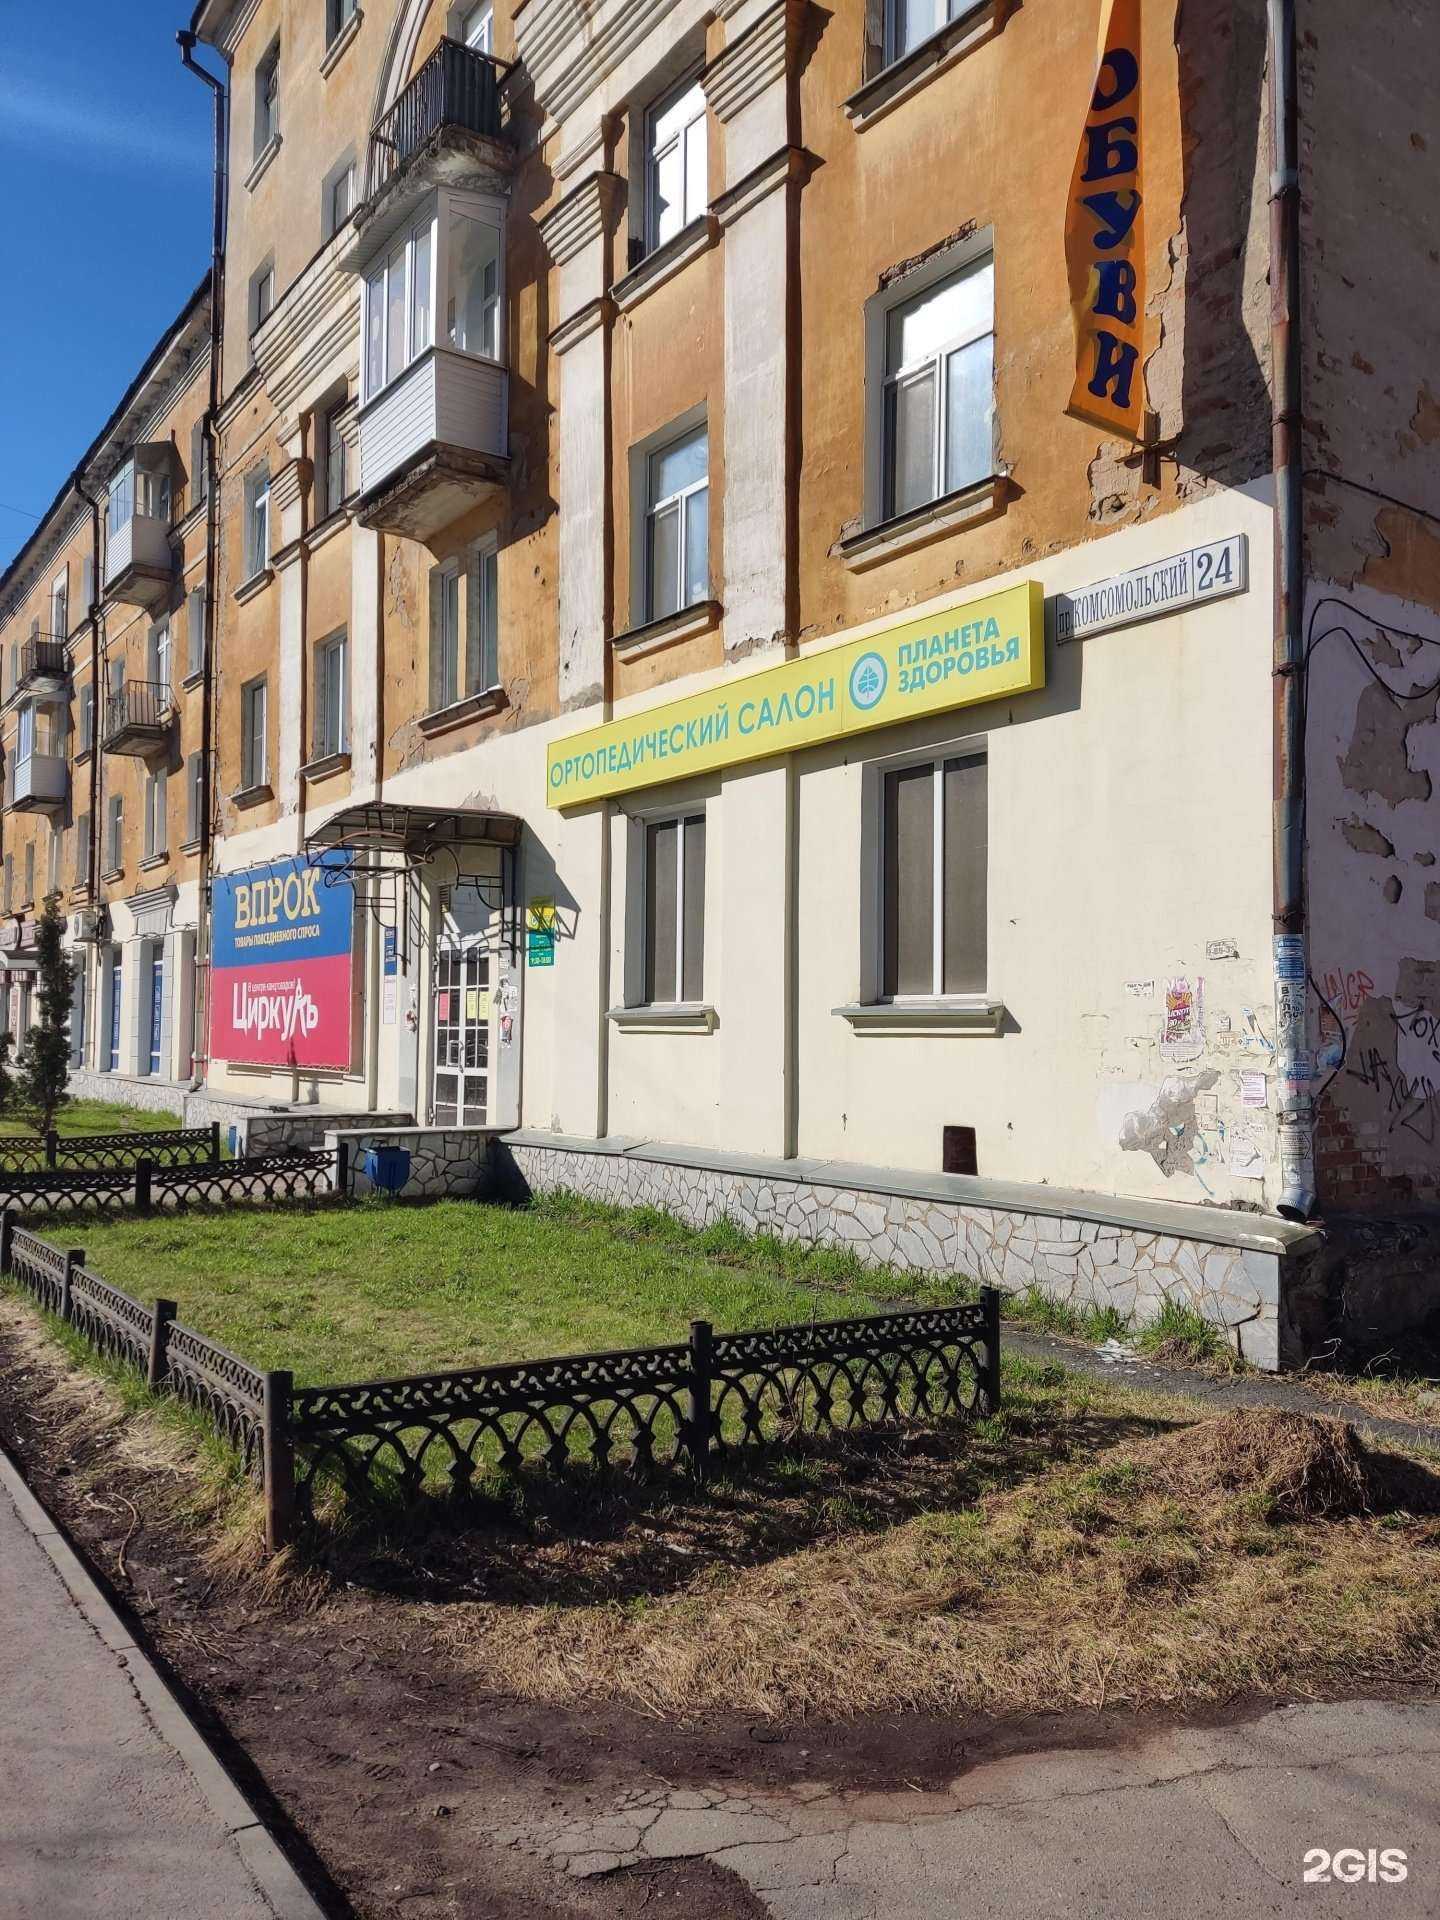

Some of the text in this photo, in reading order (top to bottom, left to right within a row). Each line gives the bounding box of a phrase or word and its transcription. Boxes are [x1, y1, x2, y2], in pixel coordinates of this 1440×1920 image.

[1080, 47, 1142, 409] ОБУВИ
[1073, 557, 1188, 628] КОМСОМОЛЬСКИЙ
[1197, 546, 1233, 591] 24
[898, 616, 1000, 667] ПЛАНЕТА
[898, 636, 1020, 693] ЗДОРОВЬЯ
[550, 677, 834, 788] ОРТОПЕДИЧЕСКИЙ САЛОН
[234, 867, 320, 929] ВПРОК
[232, 978, 319, 1041] Циркуль
